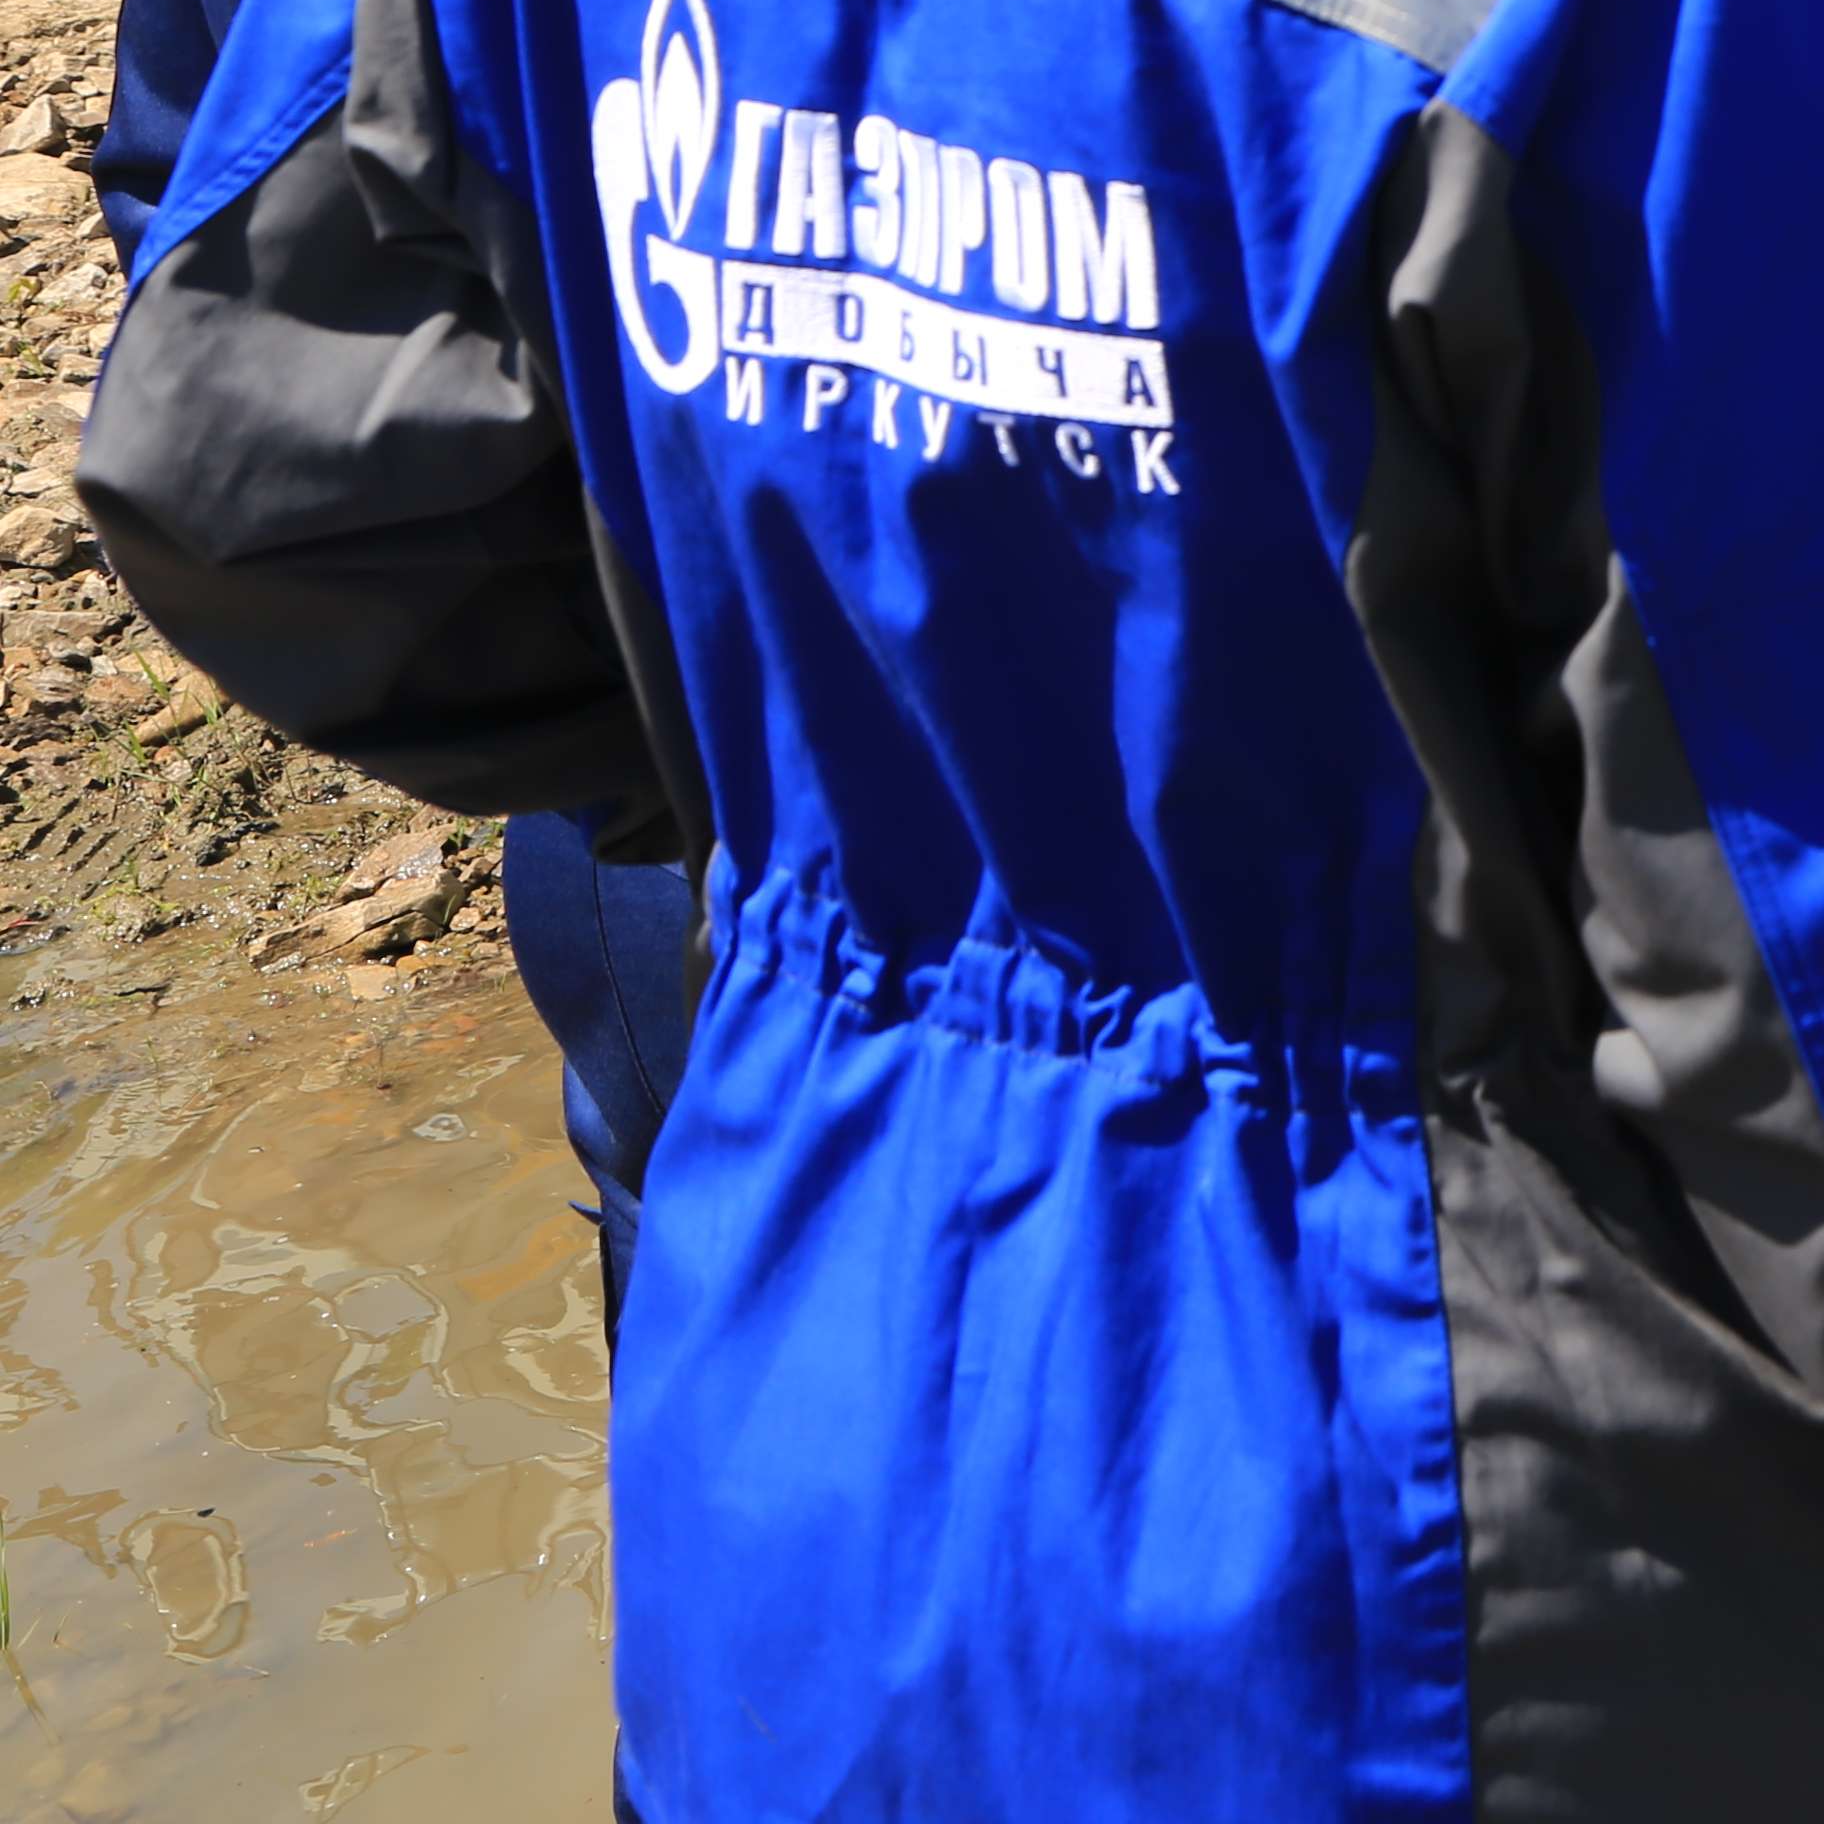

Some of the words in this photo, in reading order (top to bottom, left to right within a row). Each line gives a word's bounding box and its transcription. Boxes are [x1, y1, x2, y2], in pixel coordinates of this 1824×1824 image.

[724, 99, 1159, 330] ГАЗПРОМ
[737, 280, 1157, 408] ДОБЫЧА
[724, 354, 1181, 496] ИРКУТСК
